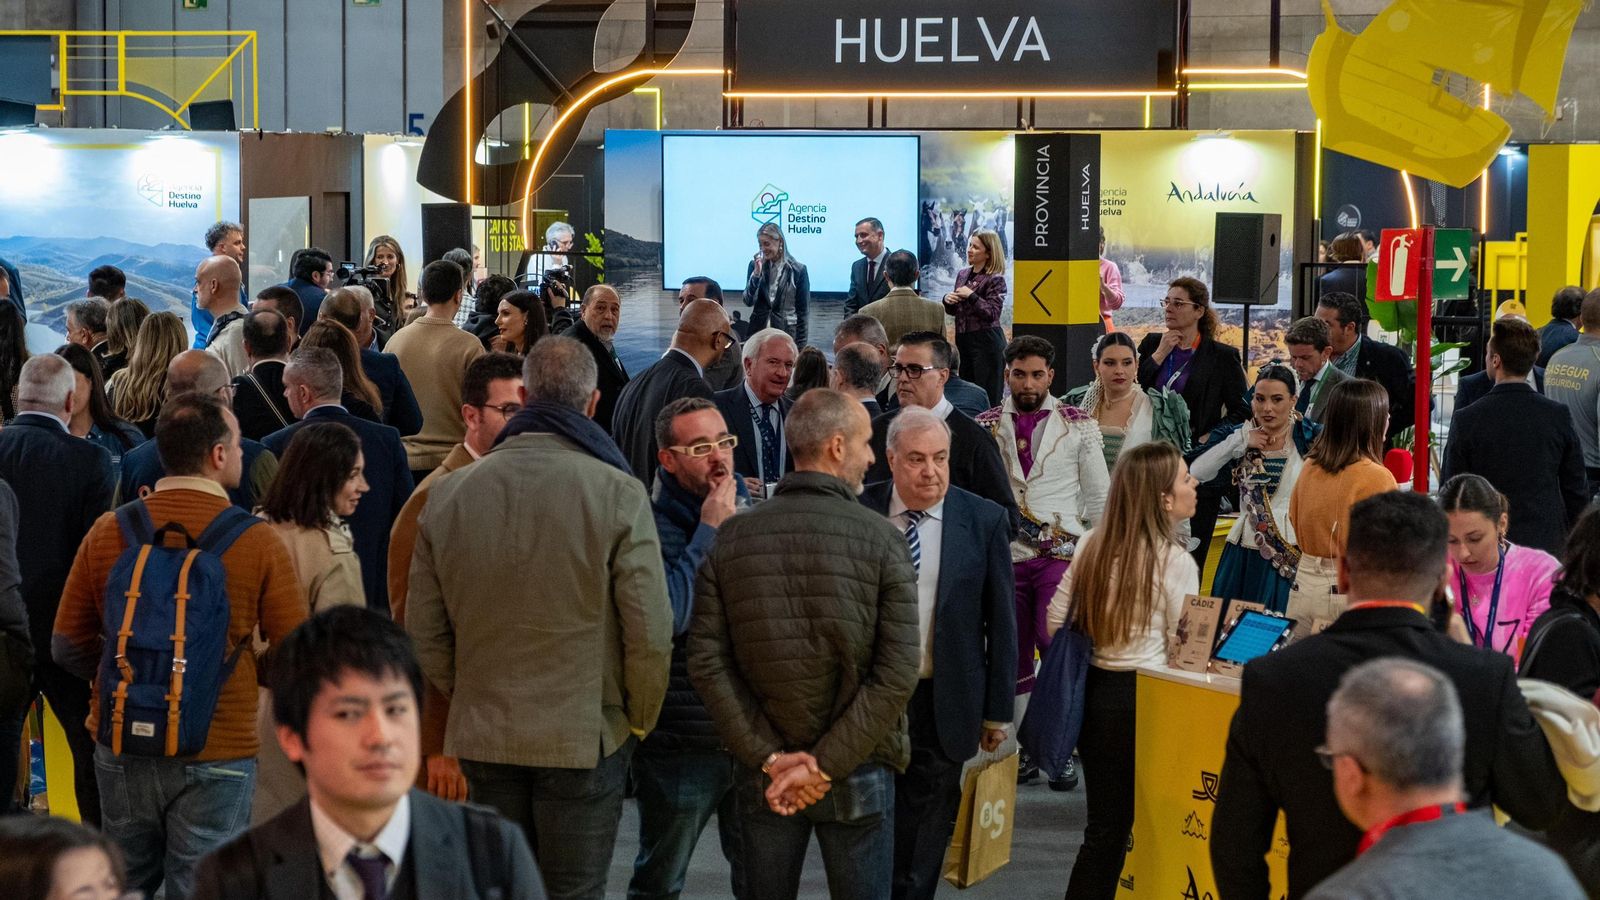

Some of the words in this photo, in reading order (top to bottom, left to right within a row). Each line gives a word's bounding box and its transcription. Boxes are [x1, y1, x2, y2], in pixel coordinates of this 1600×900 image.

[835, 16, 1051, 63] HUELVA
[168, 191, 202, 200] Destino
[1034, 144, 1051, 247] PROVINCIA
[1081, 163, 1091, 230] HUELVA
[1166, 181, 1260, 203] Andalucía
[168, 200, 198, 208] Huelva
[788, 202, 827, 214] Agencia
[788, 213, 826, 223] Destino
[788, 224, 822, 234] Huelva
